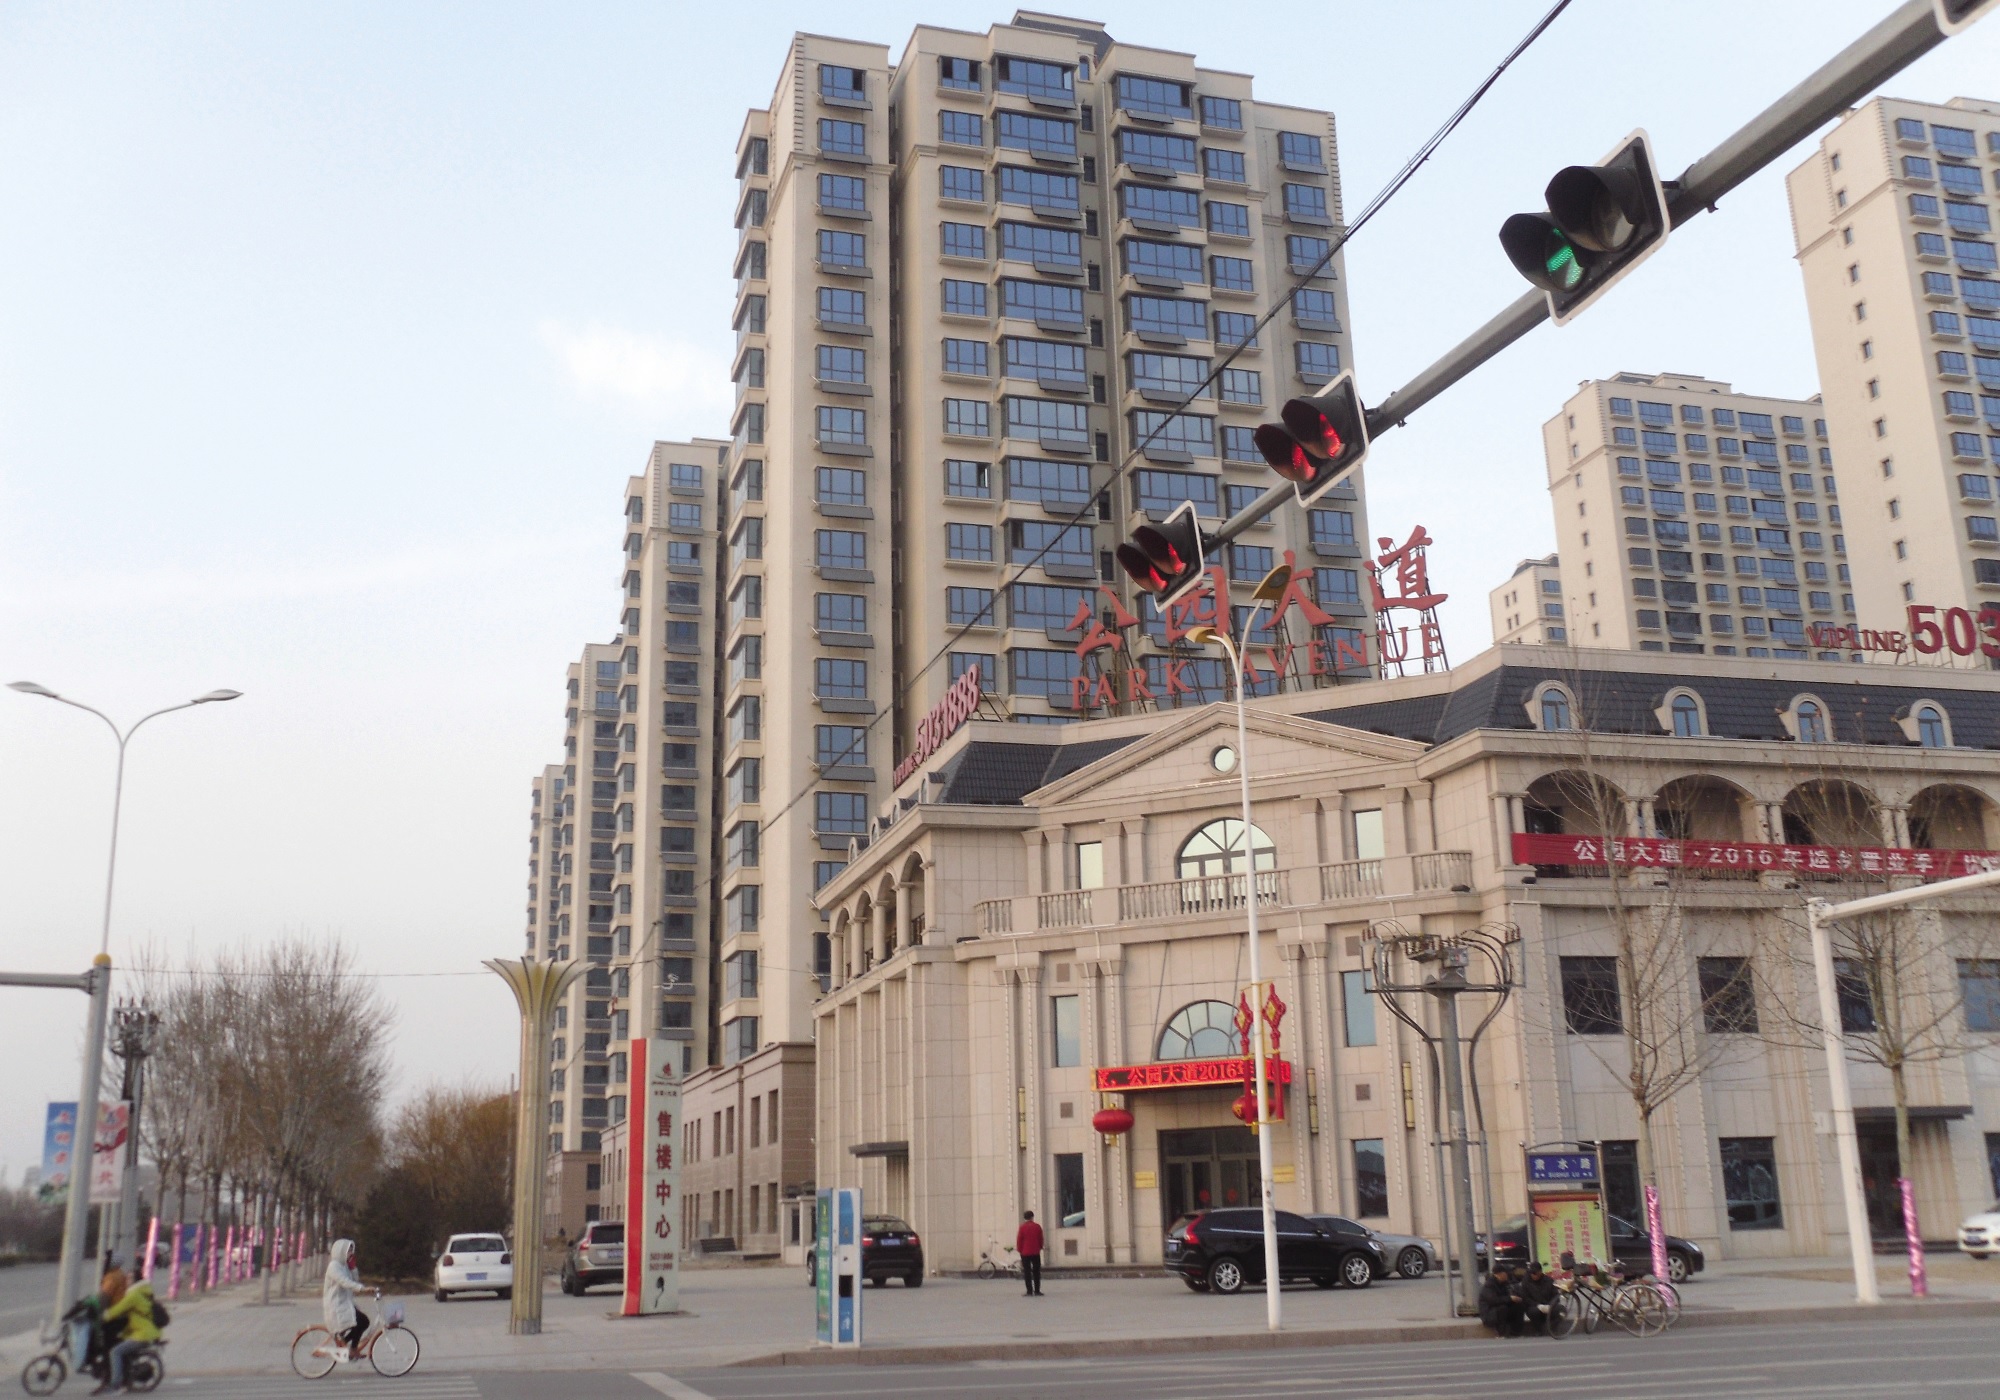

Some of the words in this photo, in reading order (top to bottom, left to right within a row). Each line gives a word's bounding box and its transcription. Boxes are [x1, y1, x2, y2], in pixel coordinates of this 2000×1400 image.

[1066, 524, 1449, 660] 公园大道
[914, 663, 980, 768] 5031888
[1071, 659, 1194, 711] PARK
[1239, 621, 1444, 686] AVENUE
[655, 1110, 672, 1239] 售楼中心
